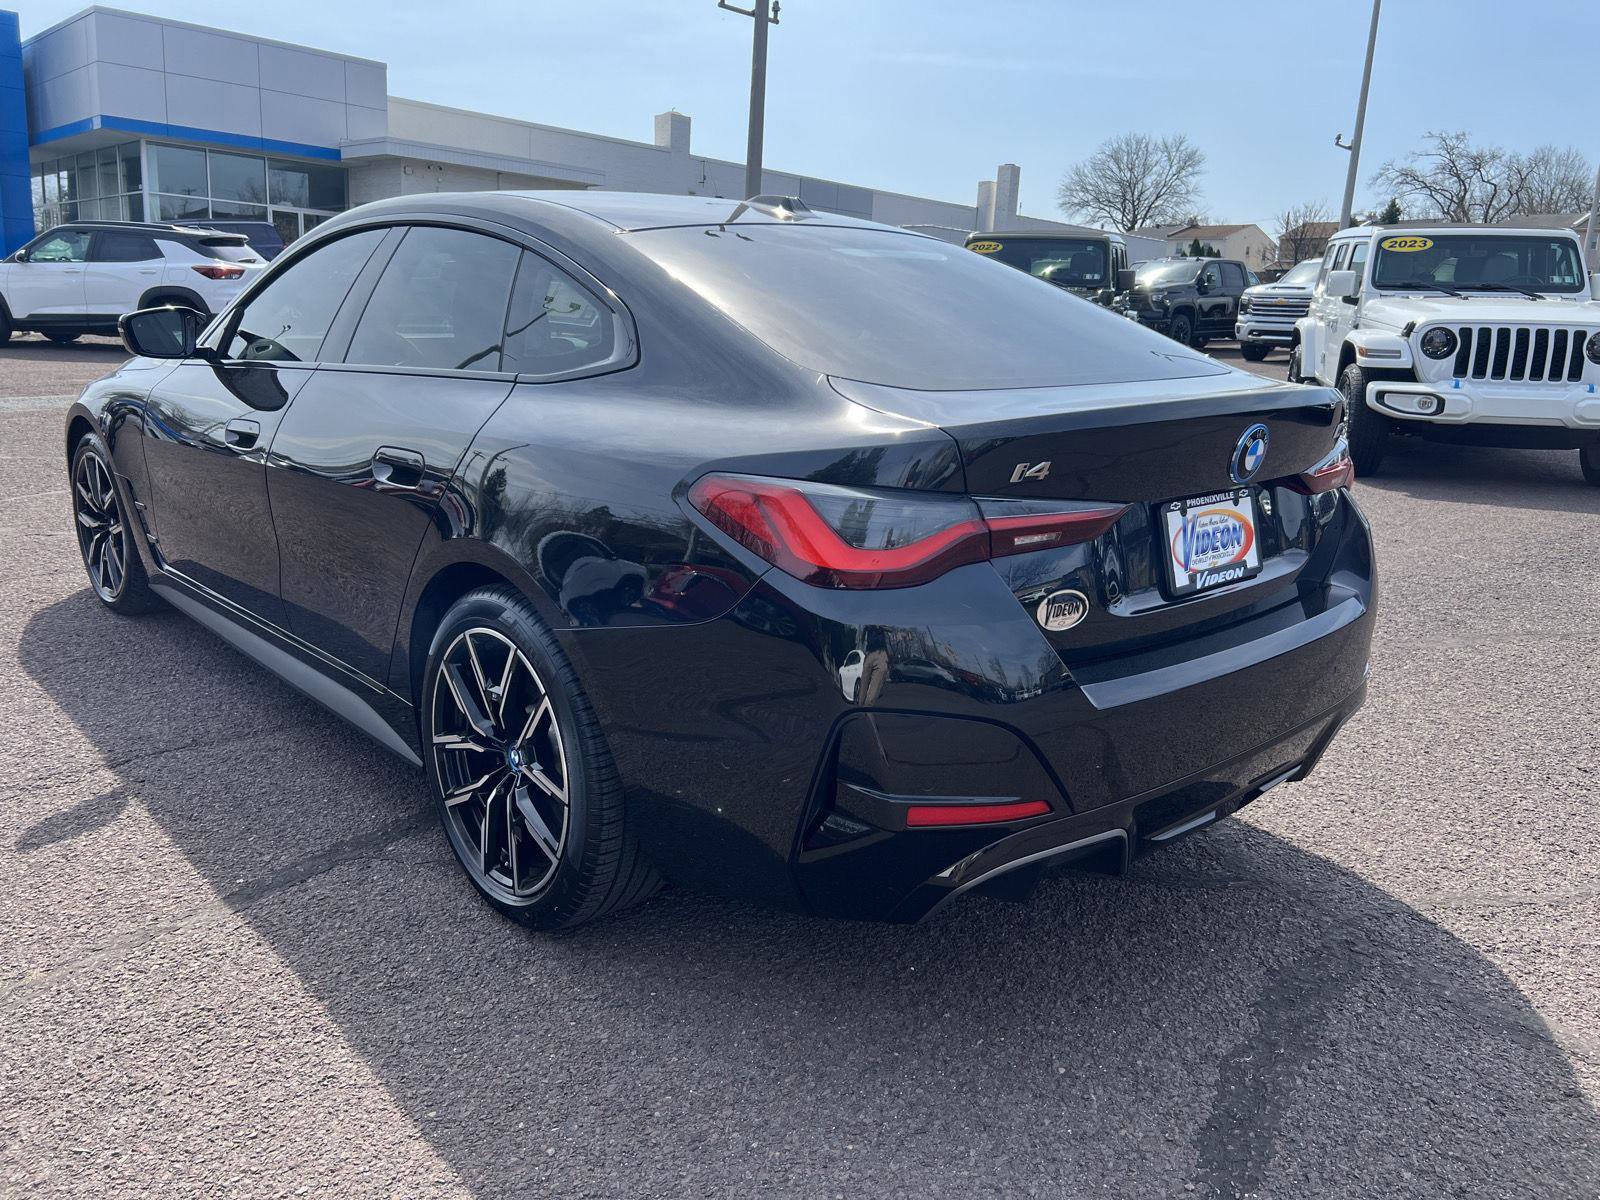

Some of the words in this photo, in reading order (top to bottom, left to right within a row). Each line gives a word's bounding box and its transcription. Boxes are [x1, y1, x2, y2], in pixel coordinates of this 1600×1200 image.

[972, 243, 1000, 251] 2022
[1387, 239, 1428, 249] 2023
[1010, 461, 1052, 483] i4
[1186, 491, 1235, 508] PHOENIXVILLE
[1182, 513, 1244, 573] VIDEON
[1196, 566, 1245, 589] VIDEON
[1044, 597, 1081, 627] VIDEON
